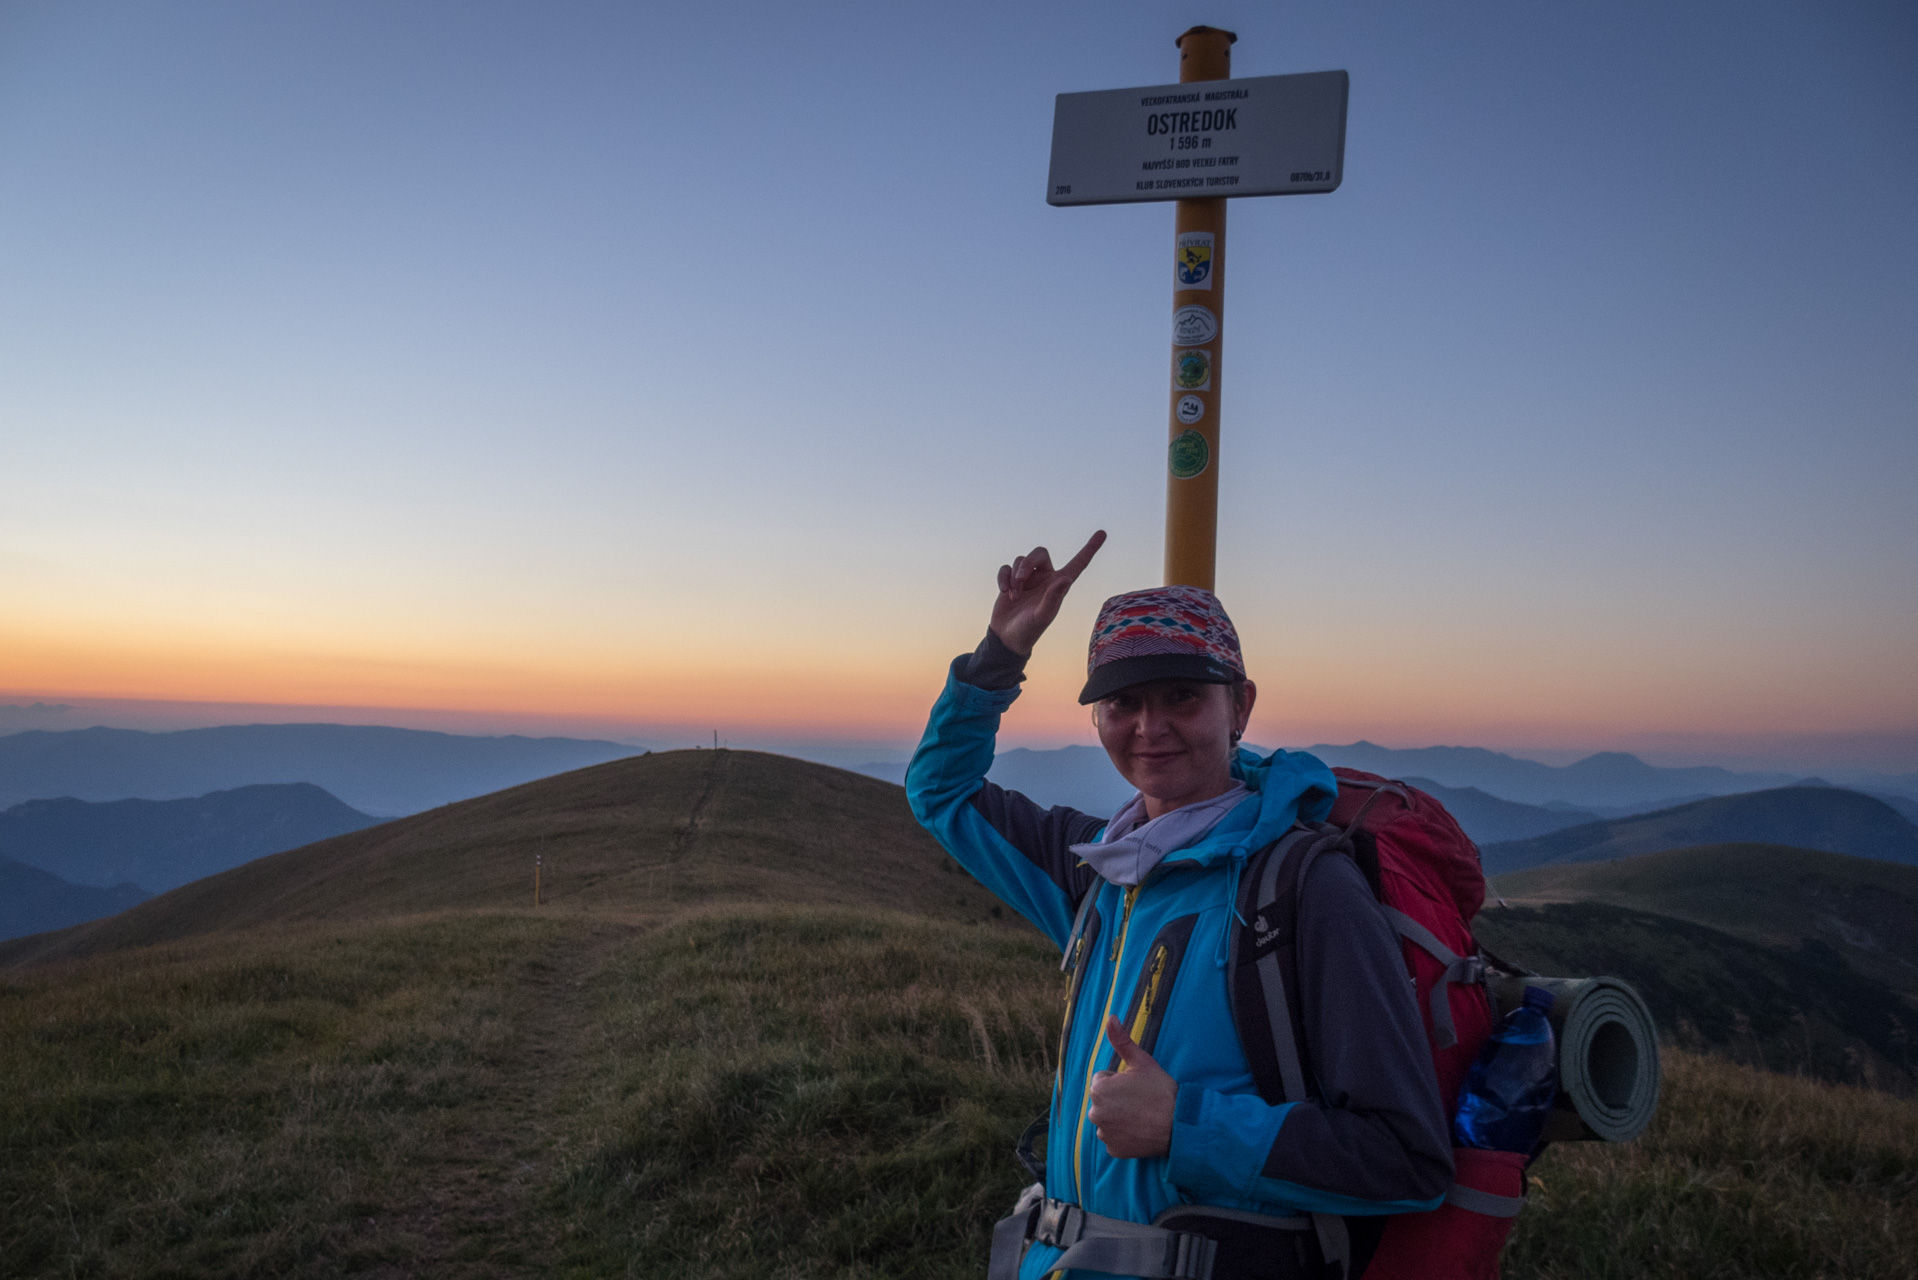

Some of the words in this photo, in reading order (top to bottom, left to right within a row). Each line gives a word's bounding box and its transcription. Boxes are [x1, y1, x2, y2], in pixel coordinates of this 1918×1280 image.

[1204, 89, 1249, 102] MAGISTRÁLA
[1147, 108, 1237, 135] OSTREDOK
[1178, 136, 1199, 150] 596
[1202, 138, 1212, 148] m
[1175, 159, 1191, 169] BOD
[1218, 156, 1240, 166] FATRY
[1136, 181, 1154, 190] KLUB
[1155, 177, 1204, 189] SLOVENSKÝCH
[1206, 176, 1240, 187] TURISTOV
[1055, 185, 1072, 195] 2016
